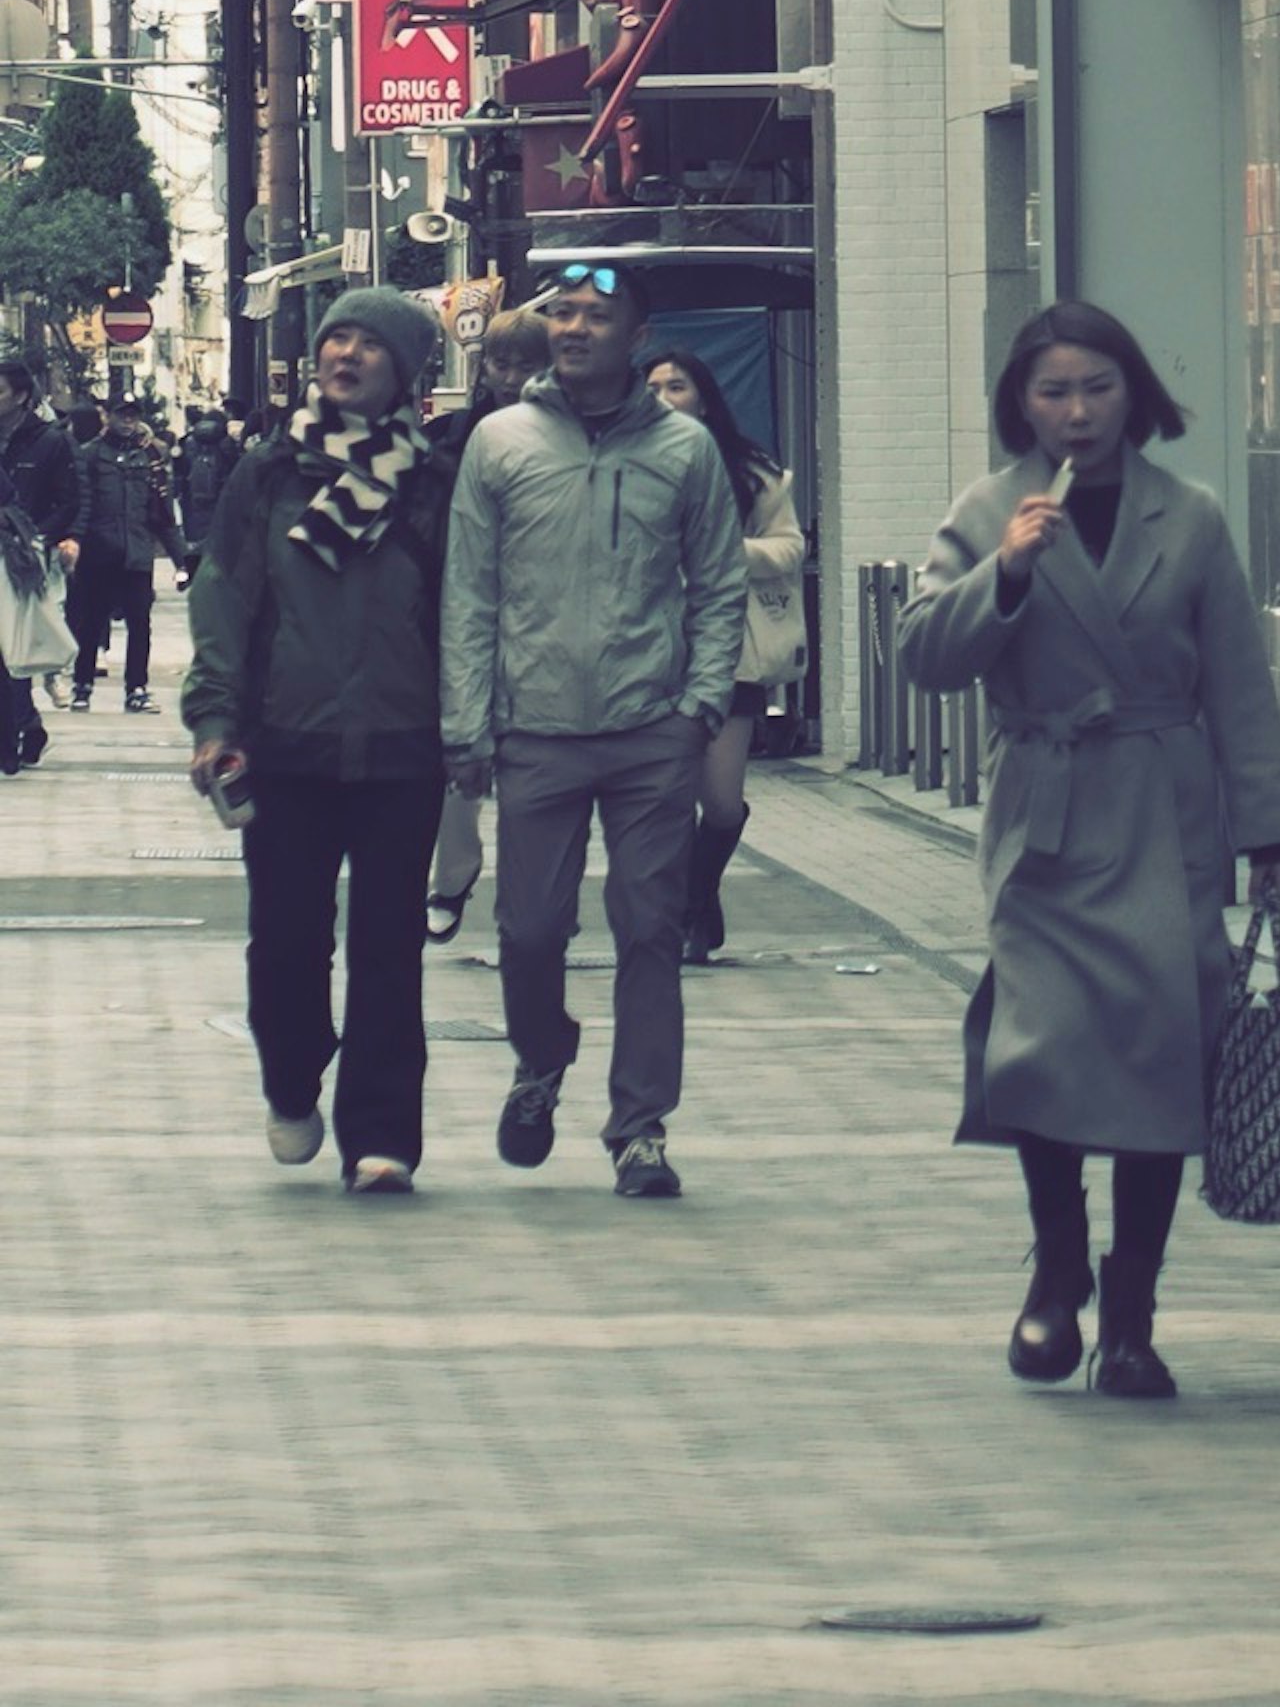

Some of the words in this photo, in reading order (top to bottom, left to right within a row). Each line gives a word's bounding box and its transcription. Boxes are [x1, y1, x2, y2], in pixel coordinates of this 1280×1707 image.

[382, 80, 441, 100] DRUG
[445, 79, 461, 100] &
[363, 102, 462, 125] COSMETIC
